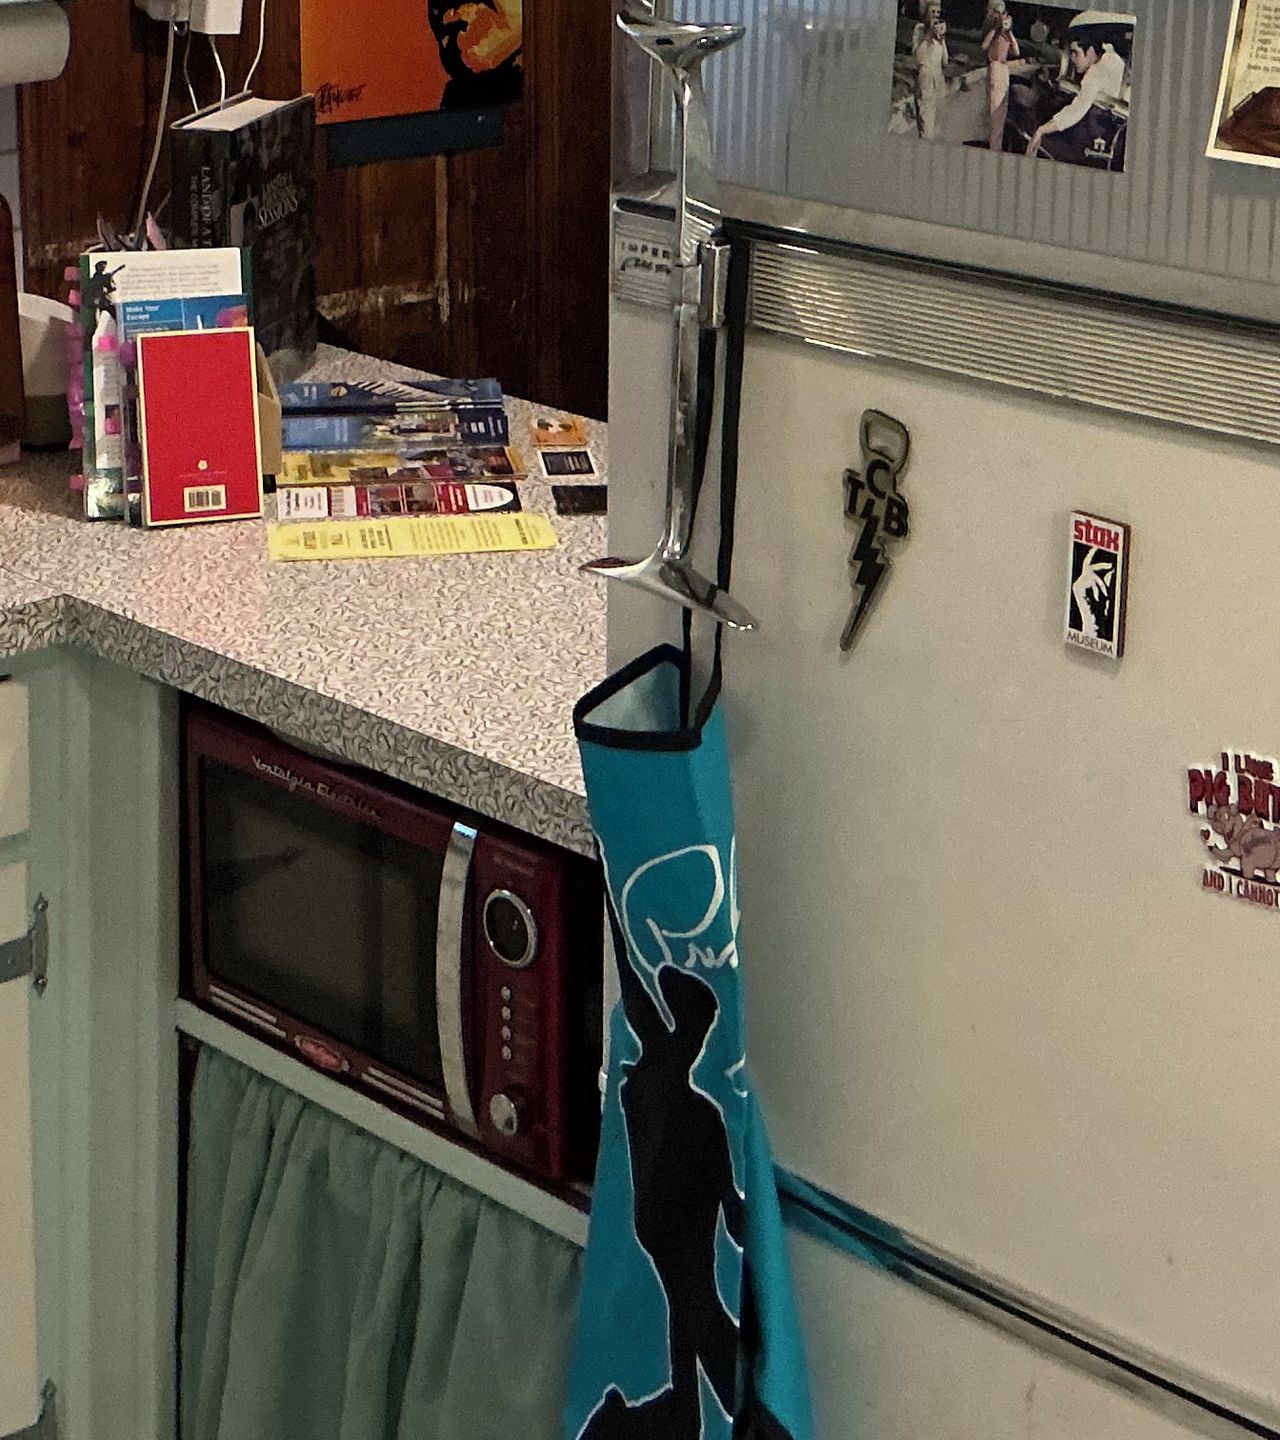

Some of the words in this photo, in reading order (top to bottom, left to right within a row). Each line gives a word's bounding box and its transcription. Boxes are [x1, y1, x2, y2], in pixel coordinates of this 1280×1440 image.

[1066, 630, 1113, 655] MUSEUM
[1202, 868, 1225, 892] AND
[1236, 879, 1280, 907] CANNOT
